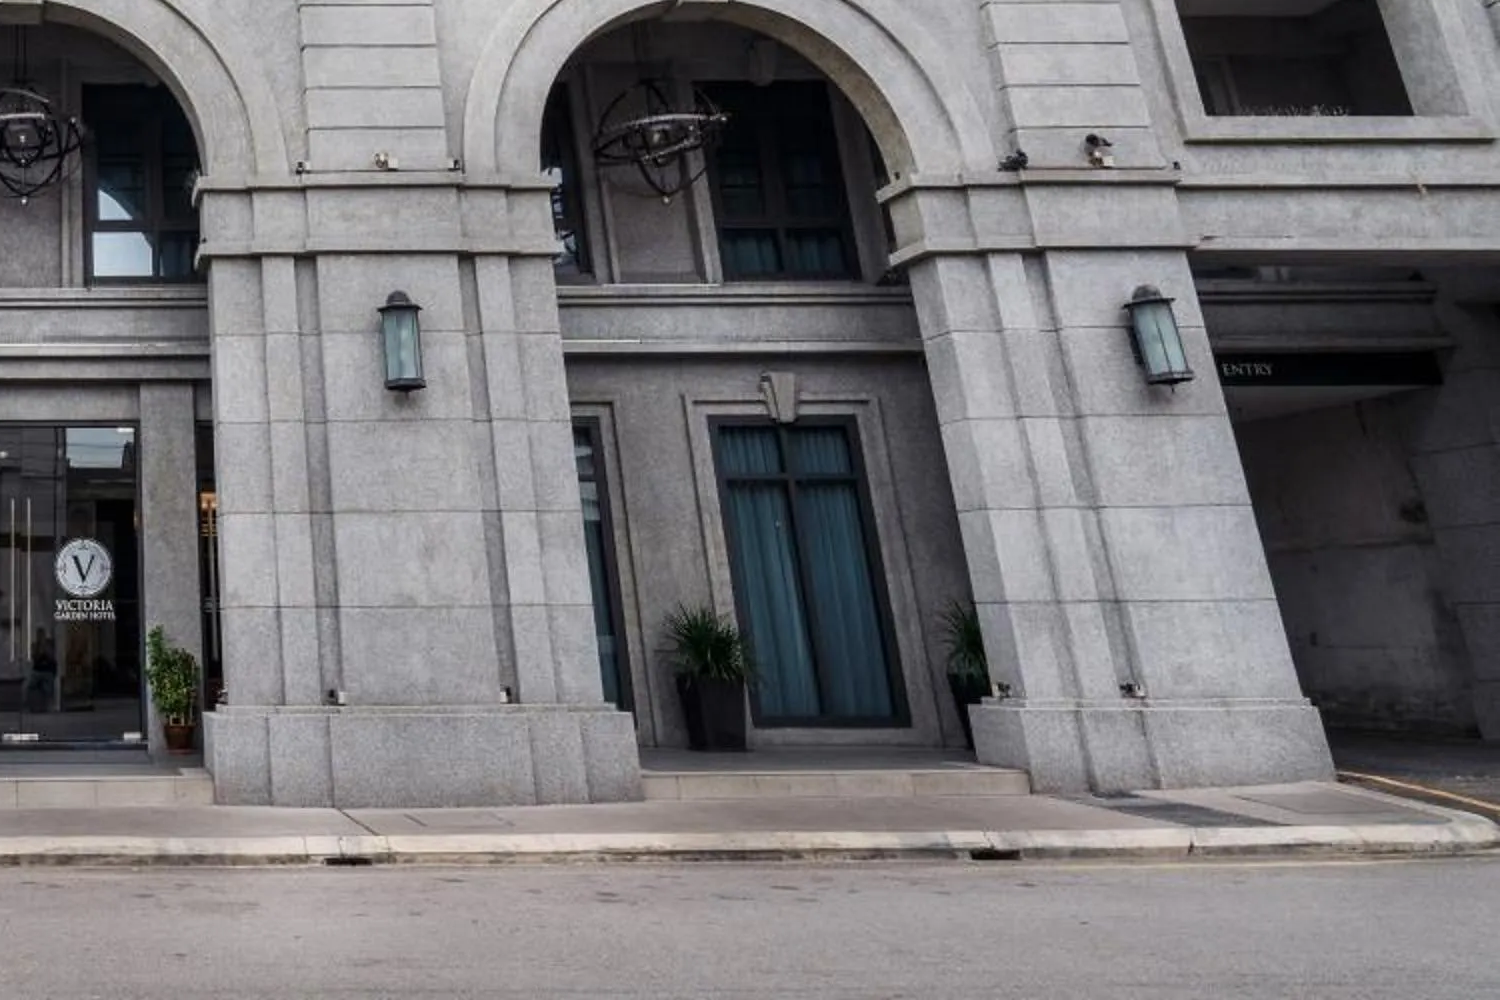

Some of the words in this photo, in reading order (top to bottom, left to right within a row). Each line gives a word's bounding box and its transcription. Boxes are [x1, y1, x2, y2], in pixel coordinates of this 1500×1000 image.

[1221, 362, 1274, 377] ENTRY
[72, 554, 96, 583] V
[55, 599, 114, 611] VICTORIA
